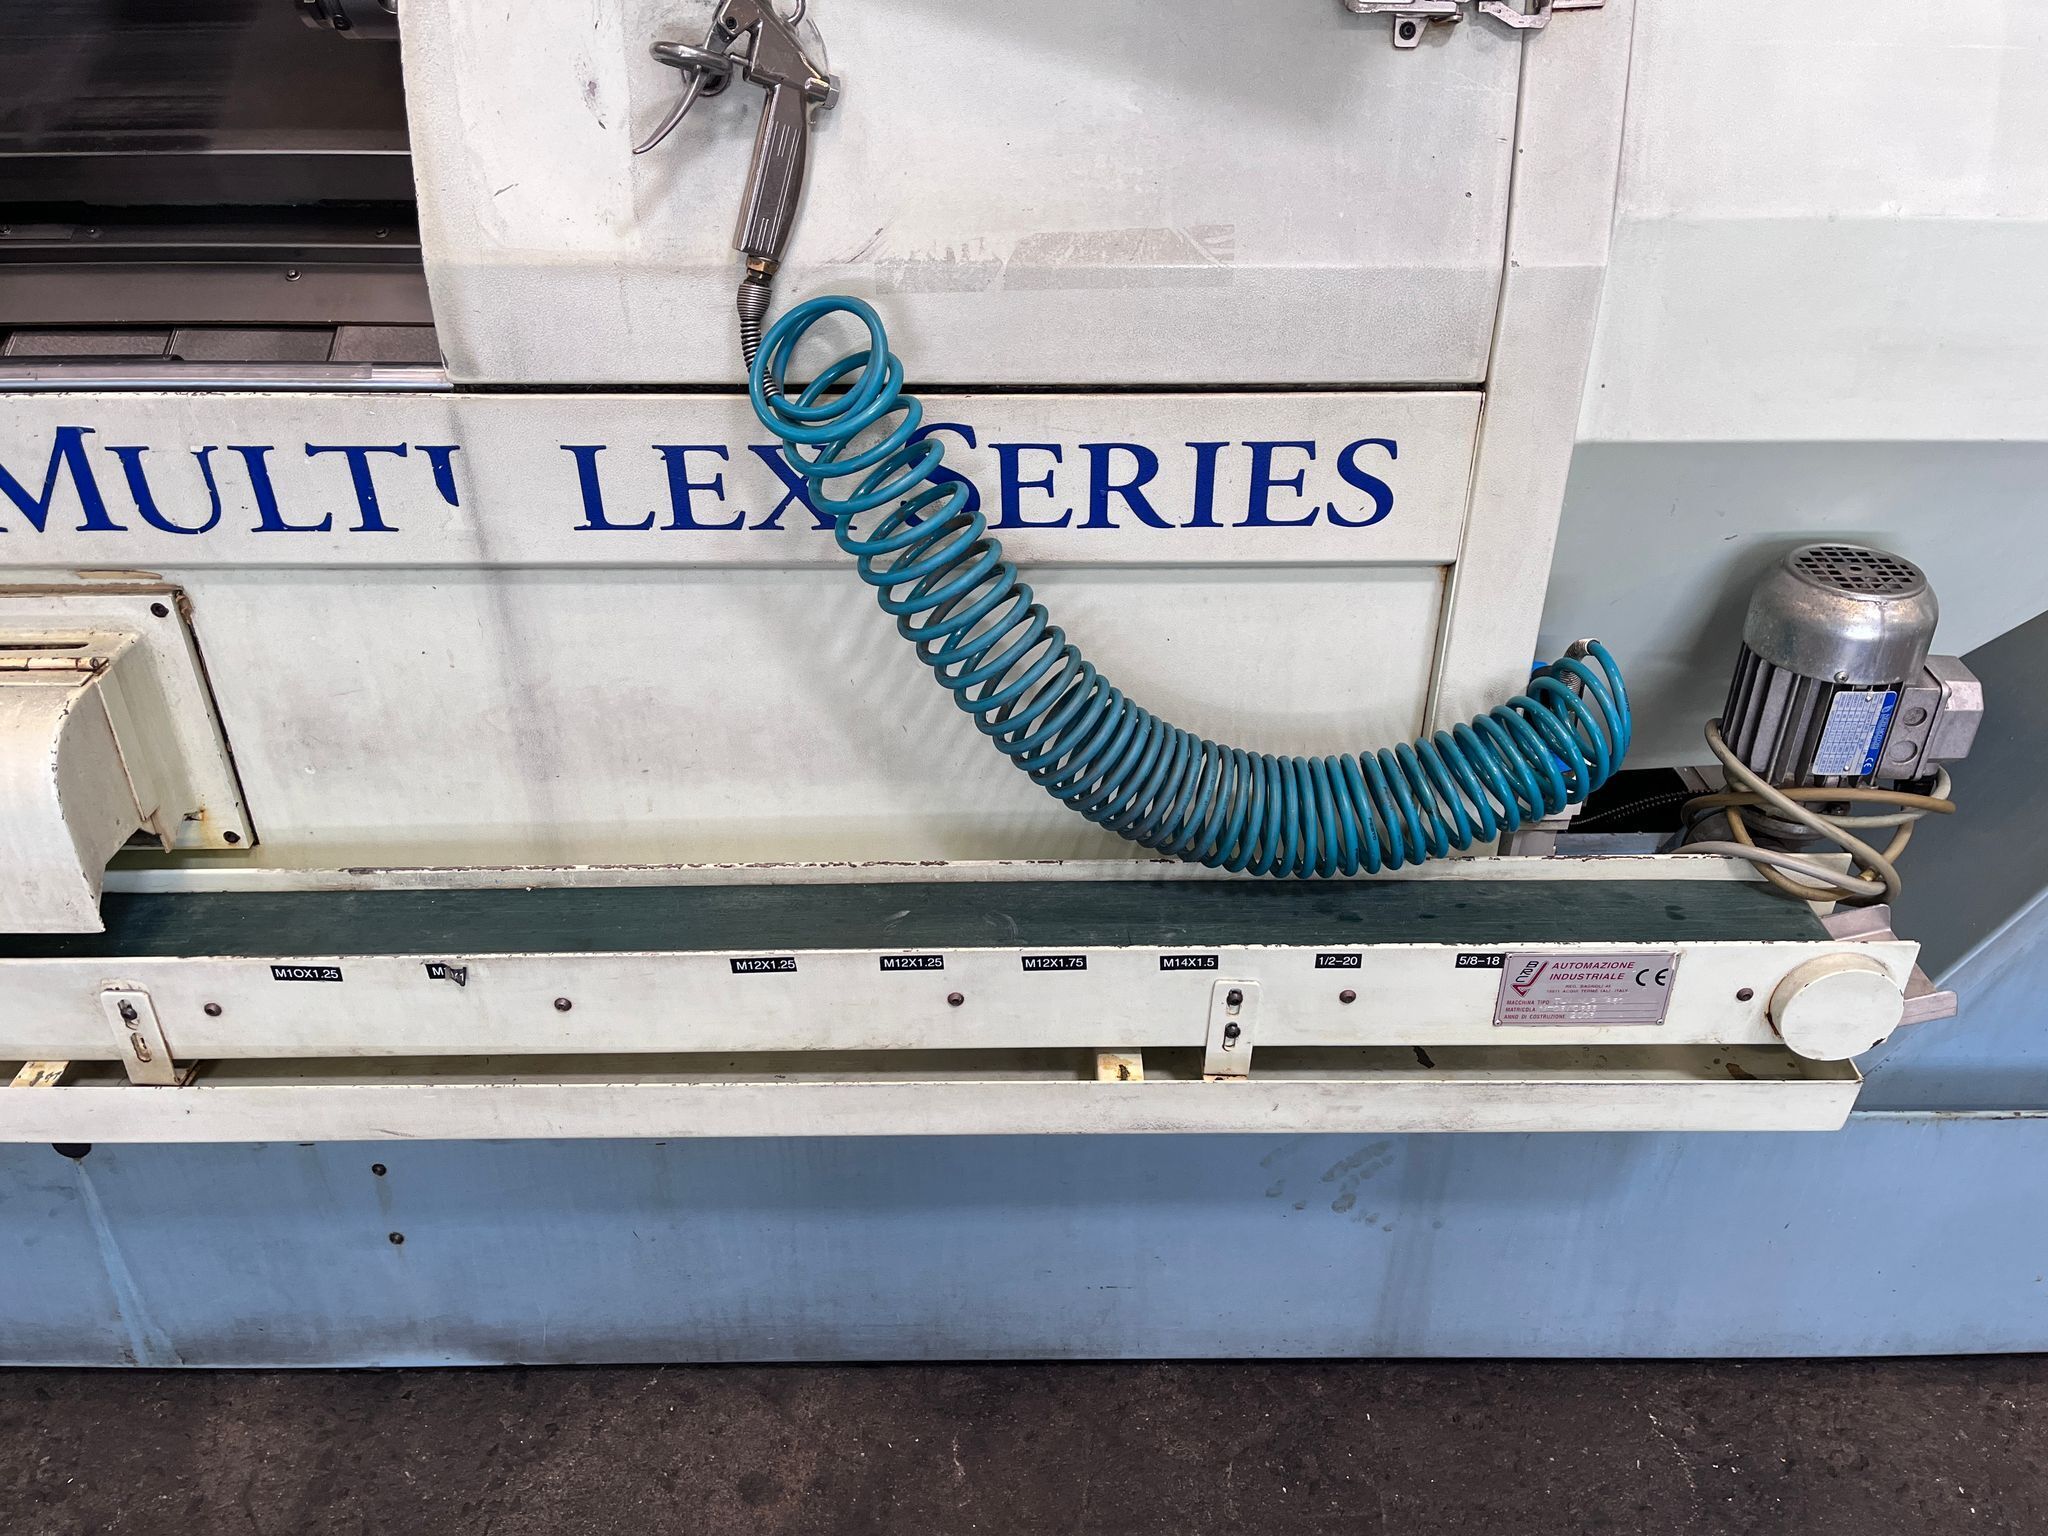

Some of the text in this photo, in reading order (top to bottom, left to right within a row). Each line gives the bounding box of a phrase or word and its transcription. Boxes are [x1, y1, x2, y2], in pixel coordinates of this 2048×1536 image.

[904, 423, 1398, 531] SERIES
[736, 959, 795, 970] M12X1.25
[883, 957, 943, 969] M12X1.25
[1025, 957, 1083, 968] M12X1.75
[1163, 957, 1215, 967] M14X1.5
[1318, 955, 1358, 966] 1/2-20
[1458, 955, 1500, 965] 5/8-18
[1551, 961, 1636, 969] AUTOMAZIONE
[1549, 973, 1626, 981] INDUSTRIALE
